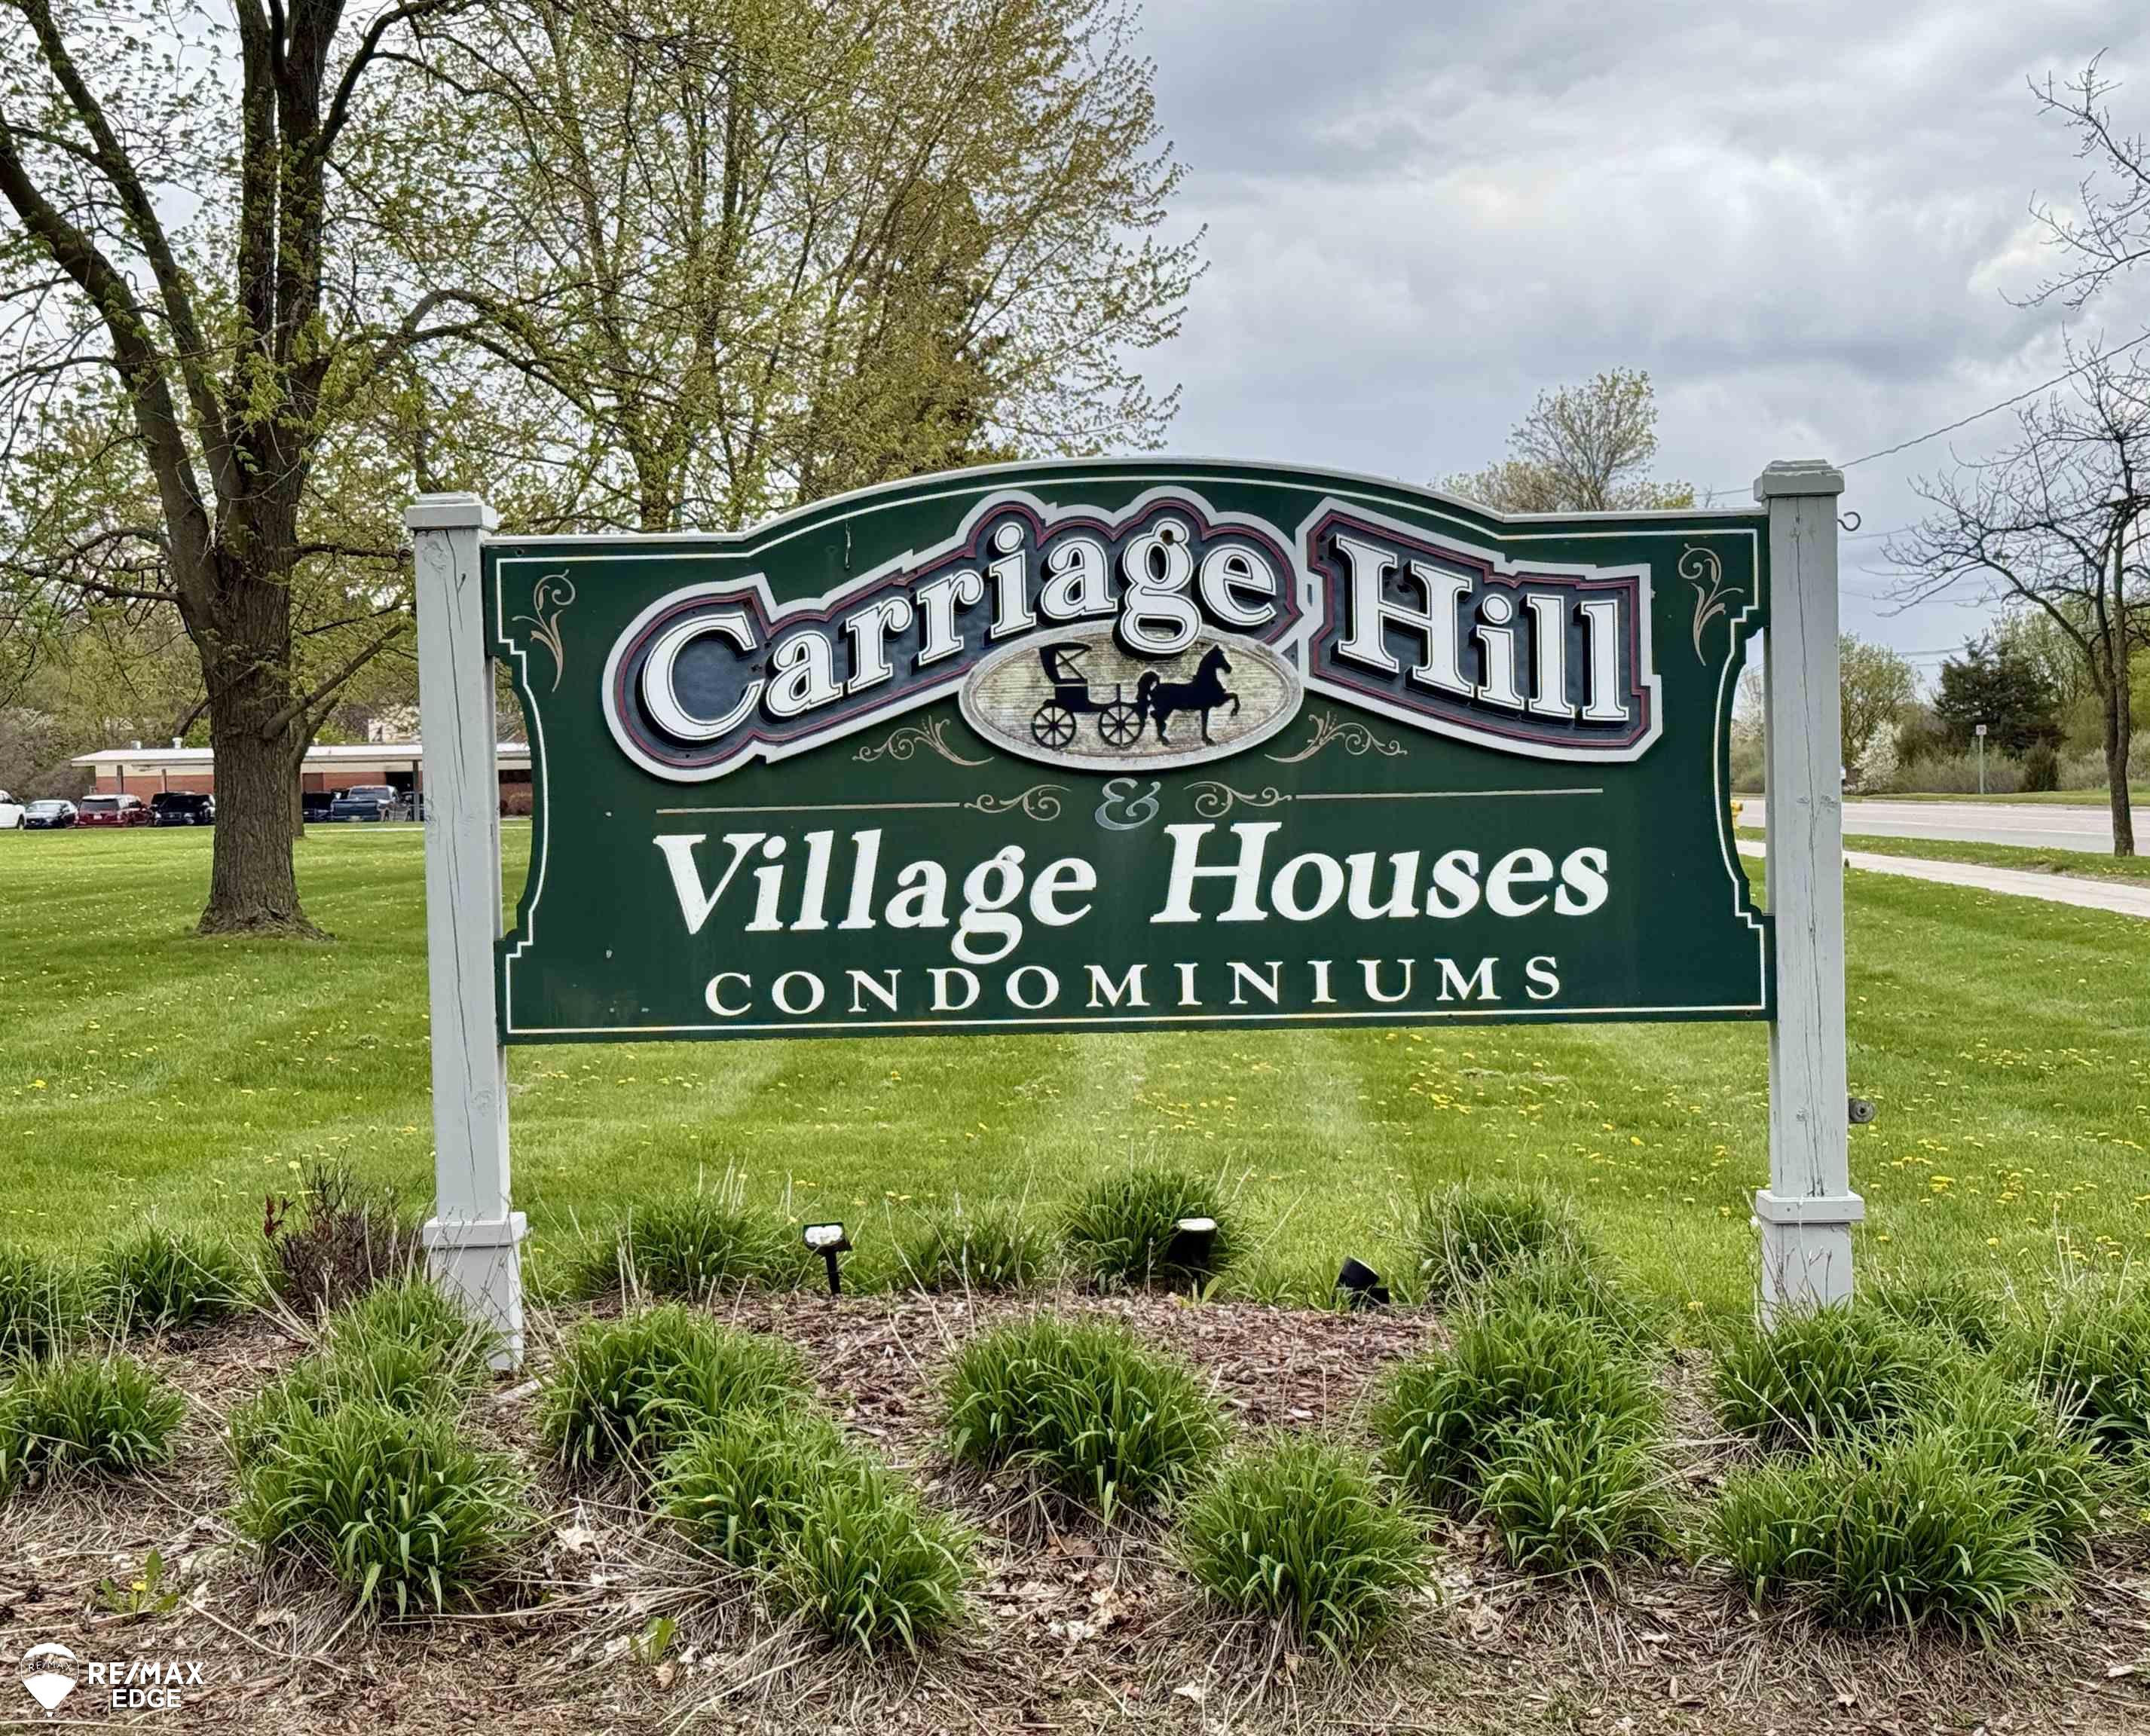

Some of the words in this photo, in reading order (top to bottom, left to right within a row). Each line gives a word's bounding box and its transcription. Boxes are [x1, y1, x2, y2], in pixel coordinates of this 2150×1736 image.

[641, 521, 1277, 741] Carriage
[1336, 536, 1629, 720] Hill
[1095, 778, 1161, 830] &
[652, 829, 1097, 964] Village
[1149, 821, 1609, 922] Houses
[705, 956, 1561, 1016] CONDOMINIUMS
